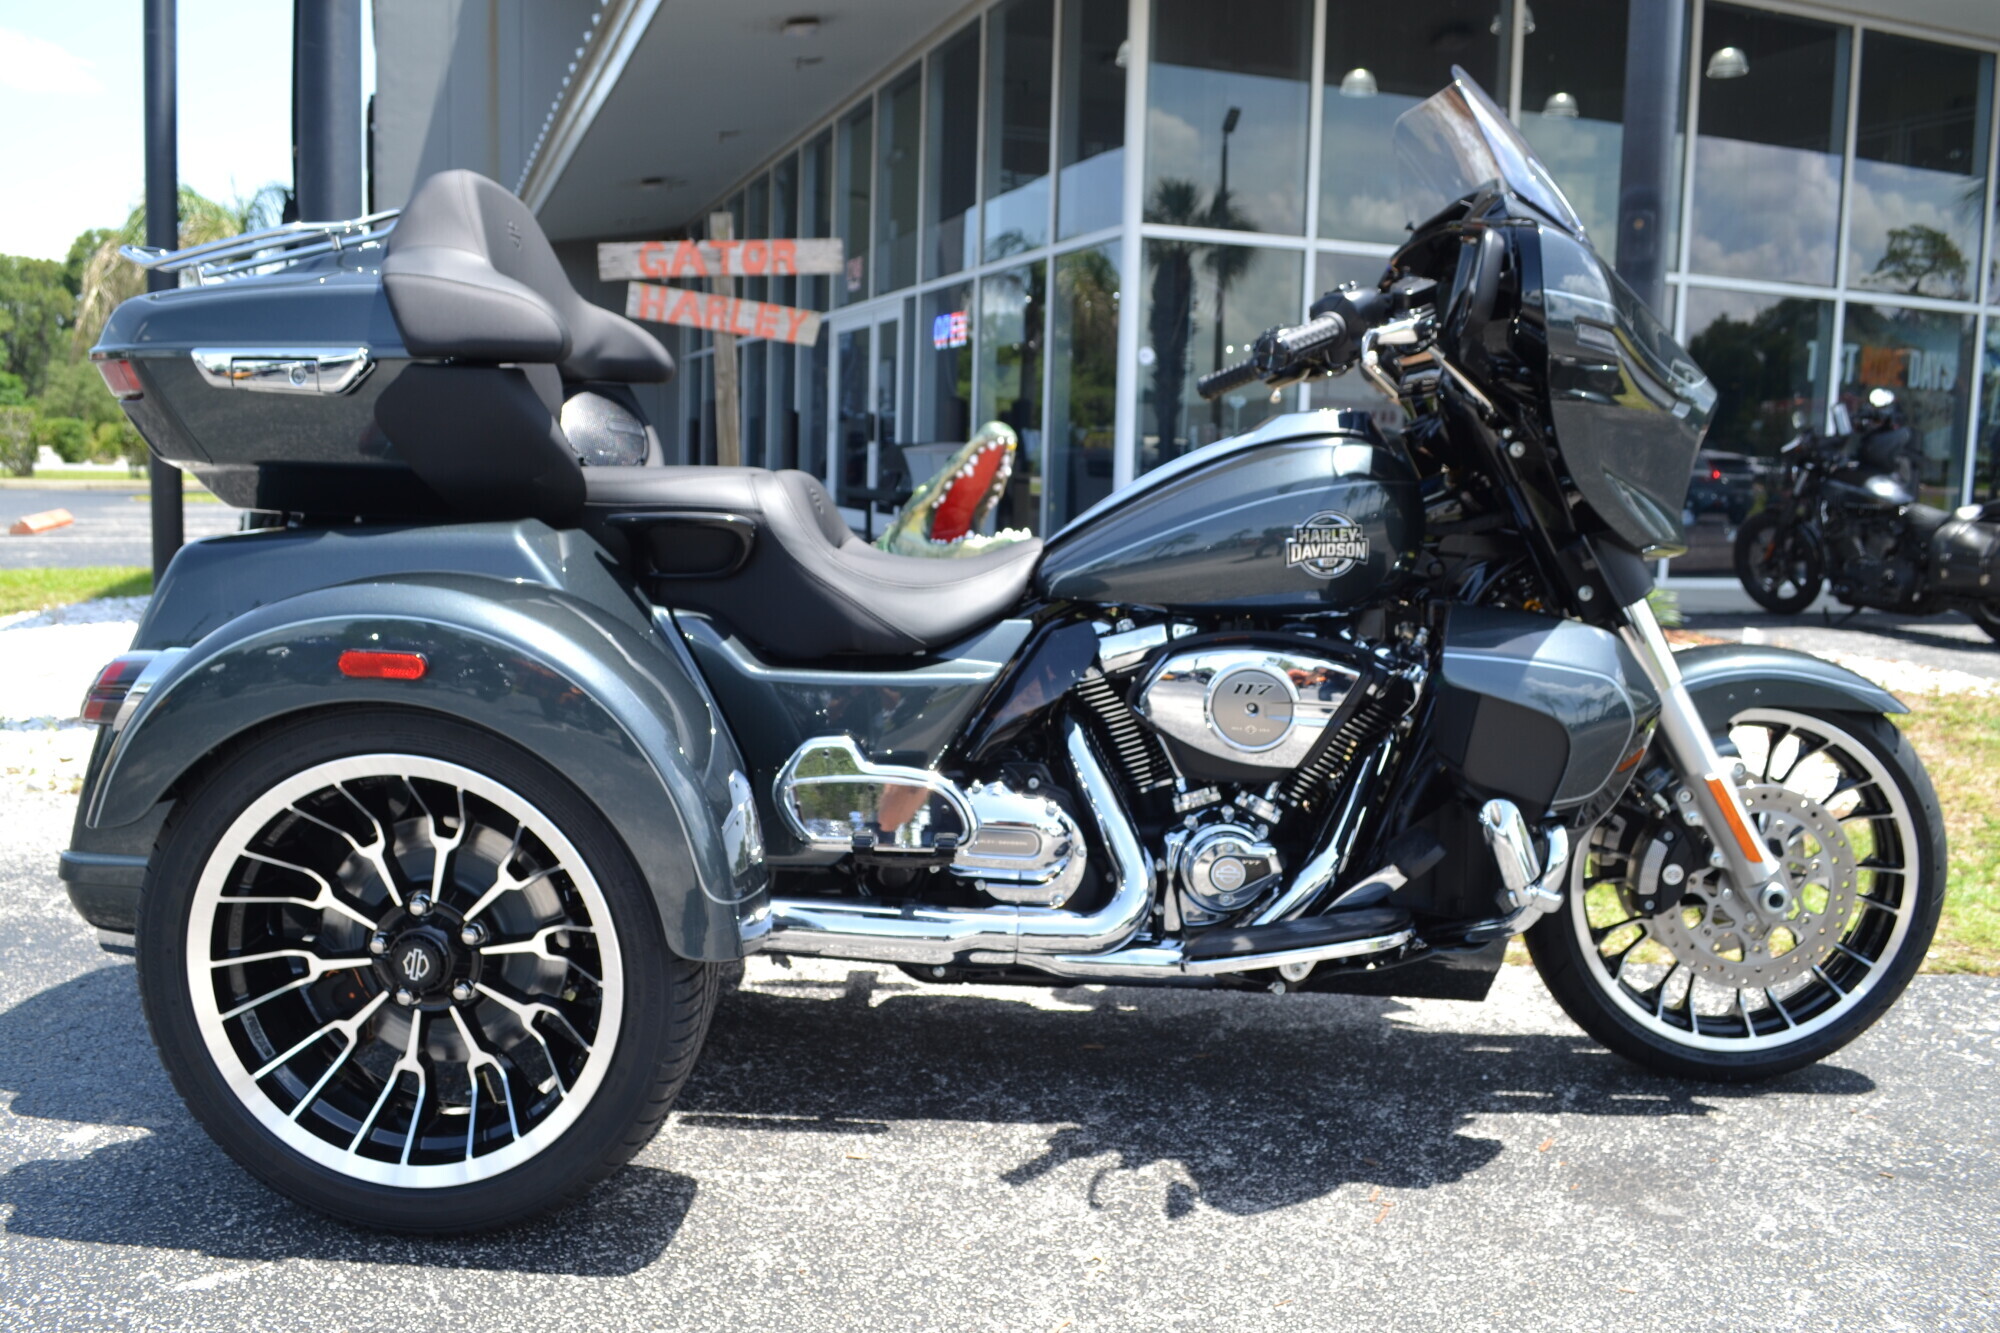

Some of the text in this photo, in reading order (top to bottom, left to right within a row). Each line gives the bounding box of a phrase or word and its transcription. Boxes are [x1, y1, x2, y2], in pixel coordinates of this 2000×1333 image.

[638, 239, 797, 277] GATOR
[639, 282, 809, 343] HARLEY
[1907, 350, 1958, 391] DAYS
[1299, 528, 1361, 542] HARLEY-
[1291, 541, 1366, 562] DAVIDSON
[1233, 683, 1274, 695] 117
